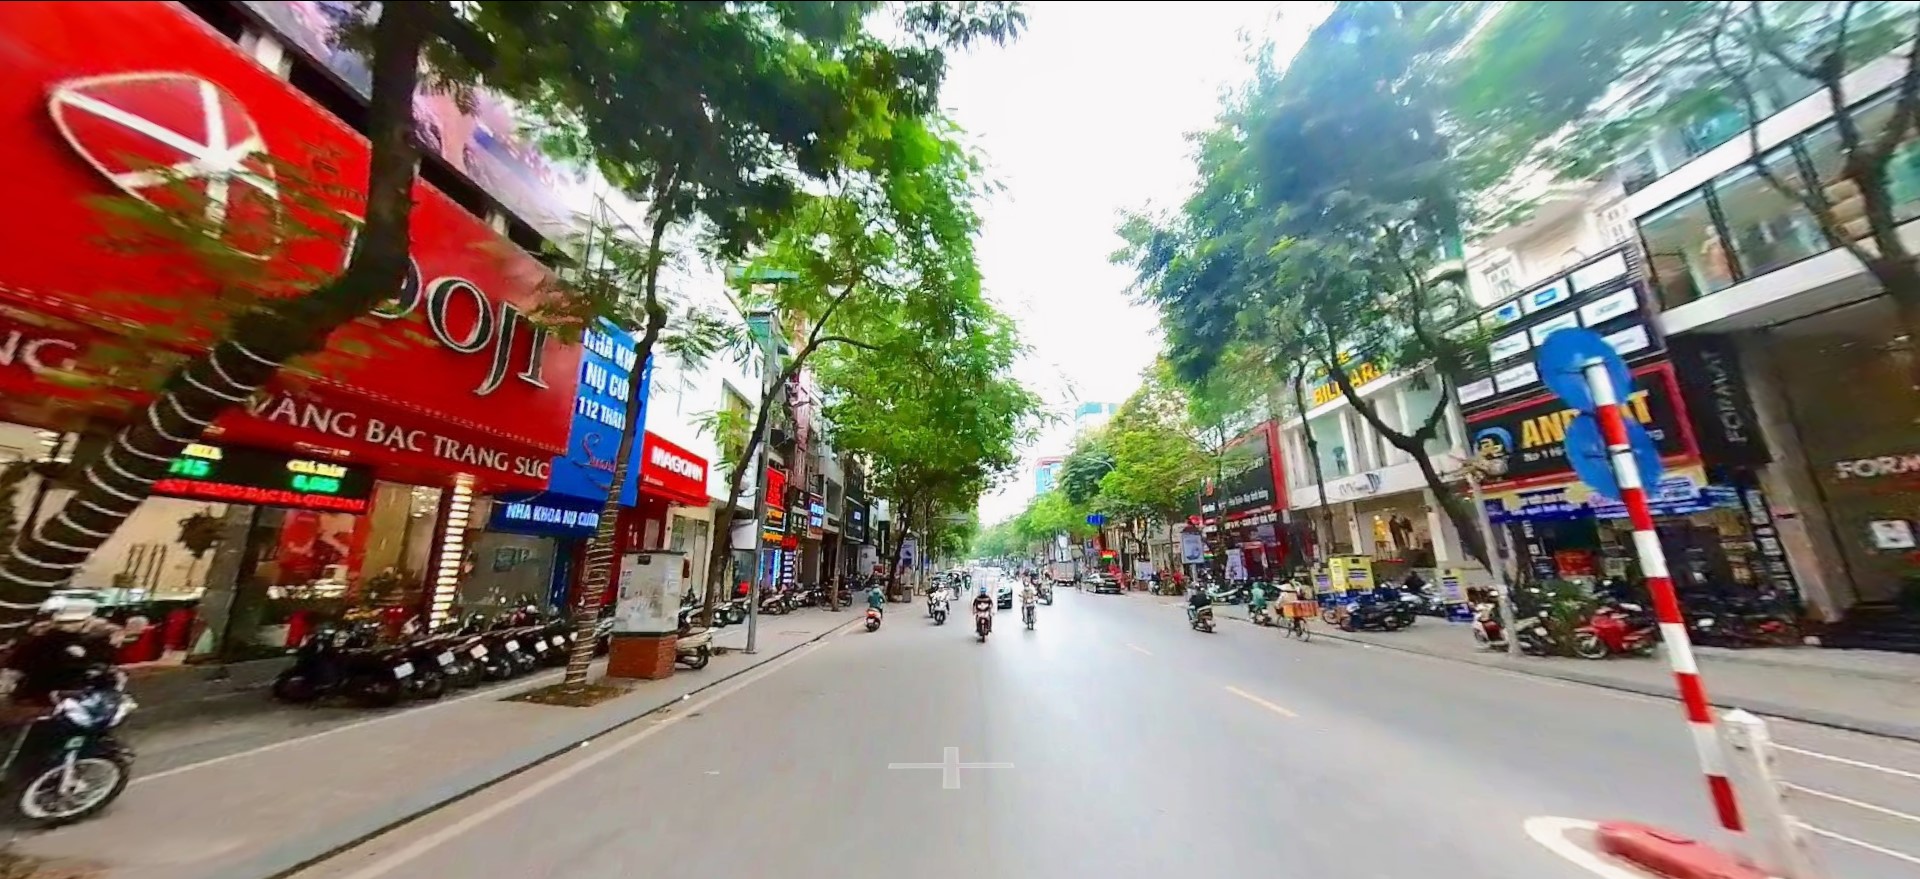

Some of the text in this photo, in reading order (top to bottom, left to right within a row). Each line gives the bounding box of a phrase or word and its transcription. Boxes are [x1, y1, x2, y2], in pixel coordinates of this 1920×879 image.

[578, 396, 600, 420] 112
[365, 418, 427, 452] BẠC
[433, 434, 508, 473] TRANG
[513, 455, 550, 481] SỨC
